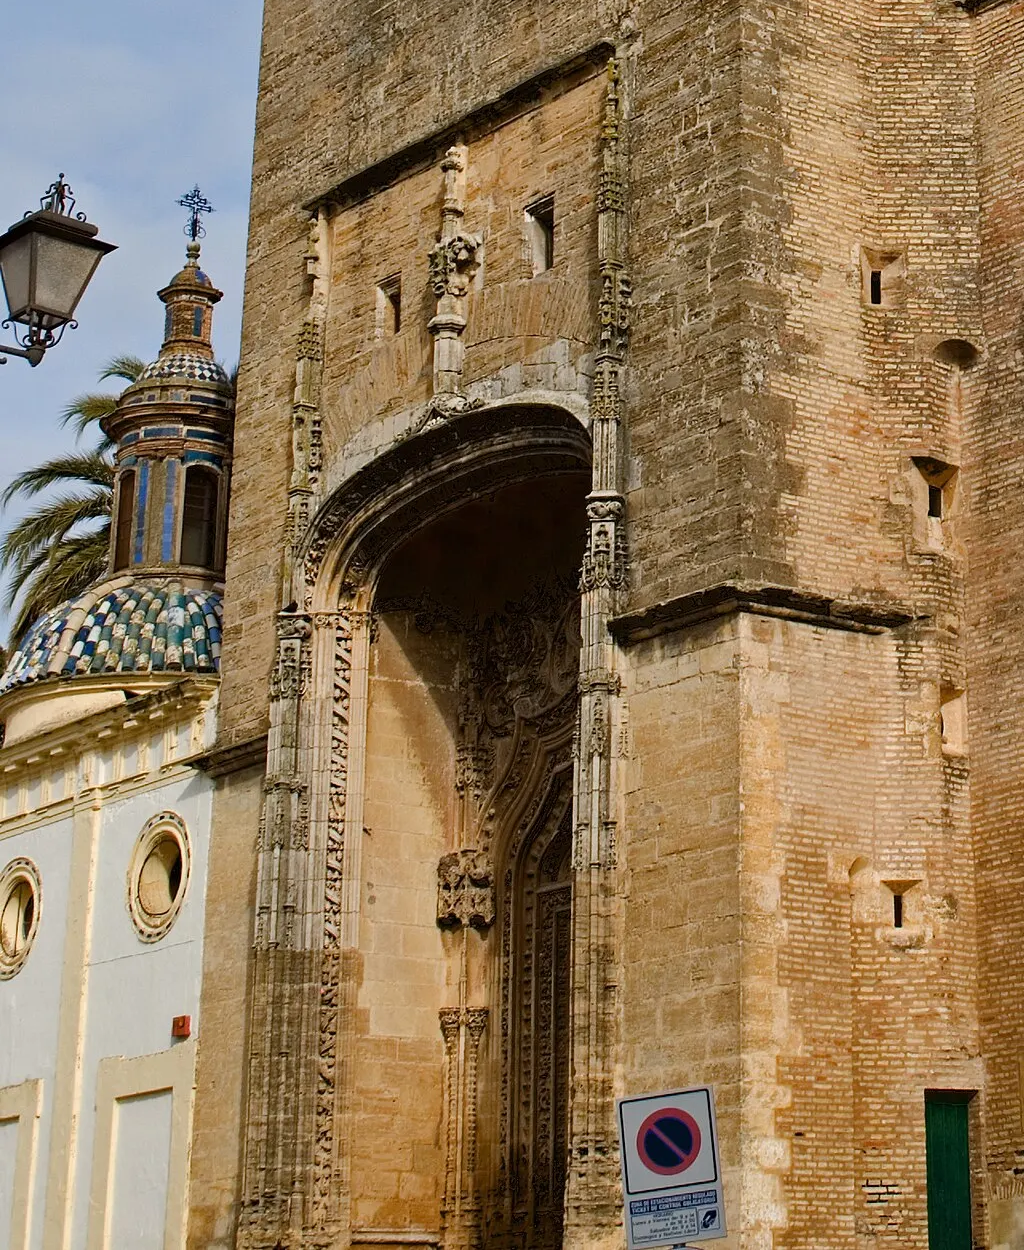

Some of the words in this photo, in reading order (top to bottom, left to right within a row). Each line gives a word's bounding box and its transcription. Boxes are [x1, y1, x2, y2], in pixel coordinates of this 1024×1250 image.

[651, 1194, 691, 1205] ESTACIONAMIENTO
[693, 1190, 716, 1198] REGULADO
[682, 1197, 716, 1206] OBLIGATORIO
